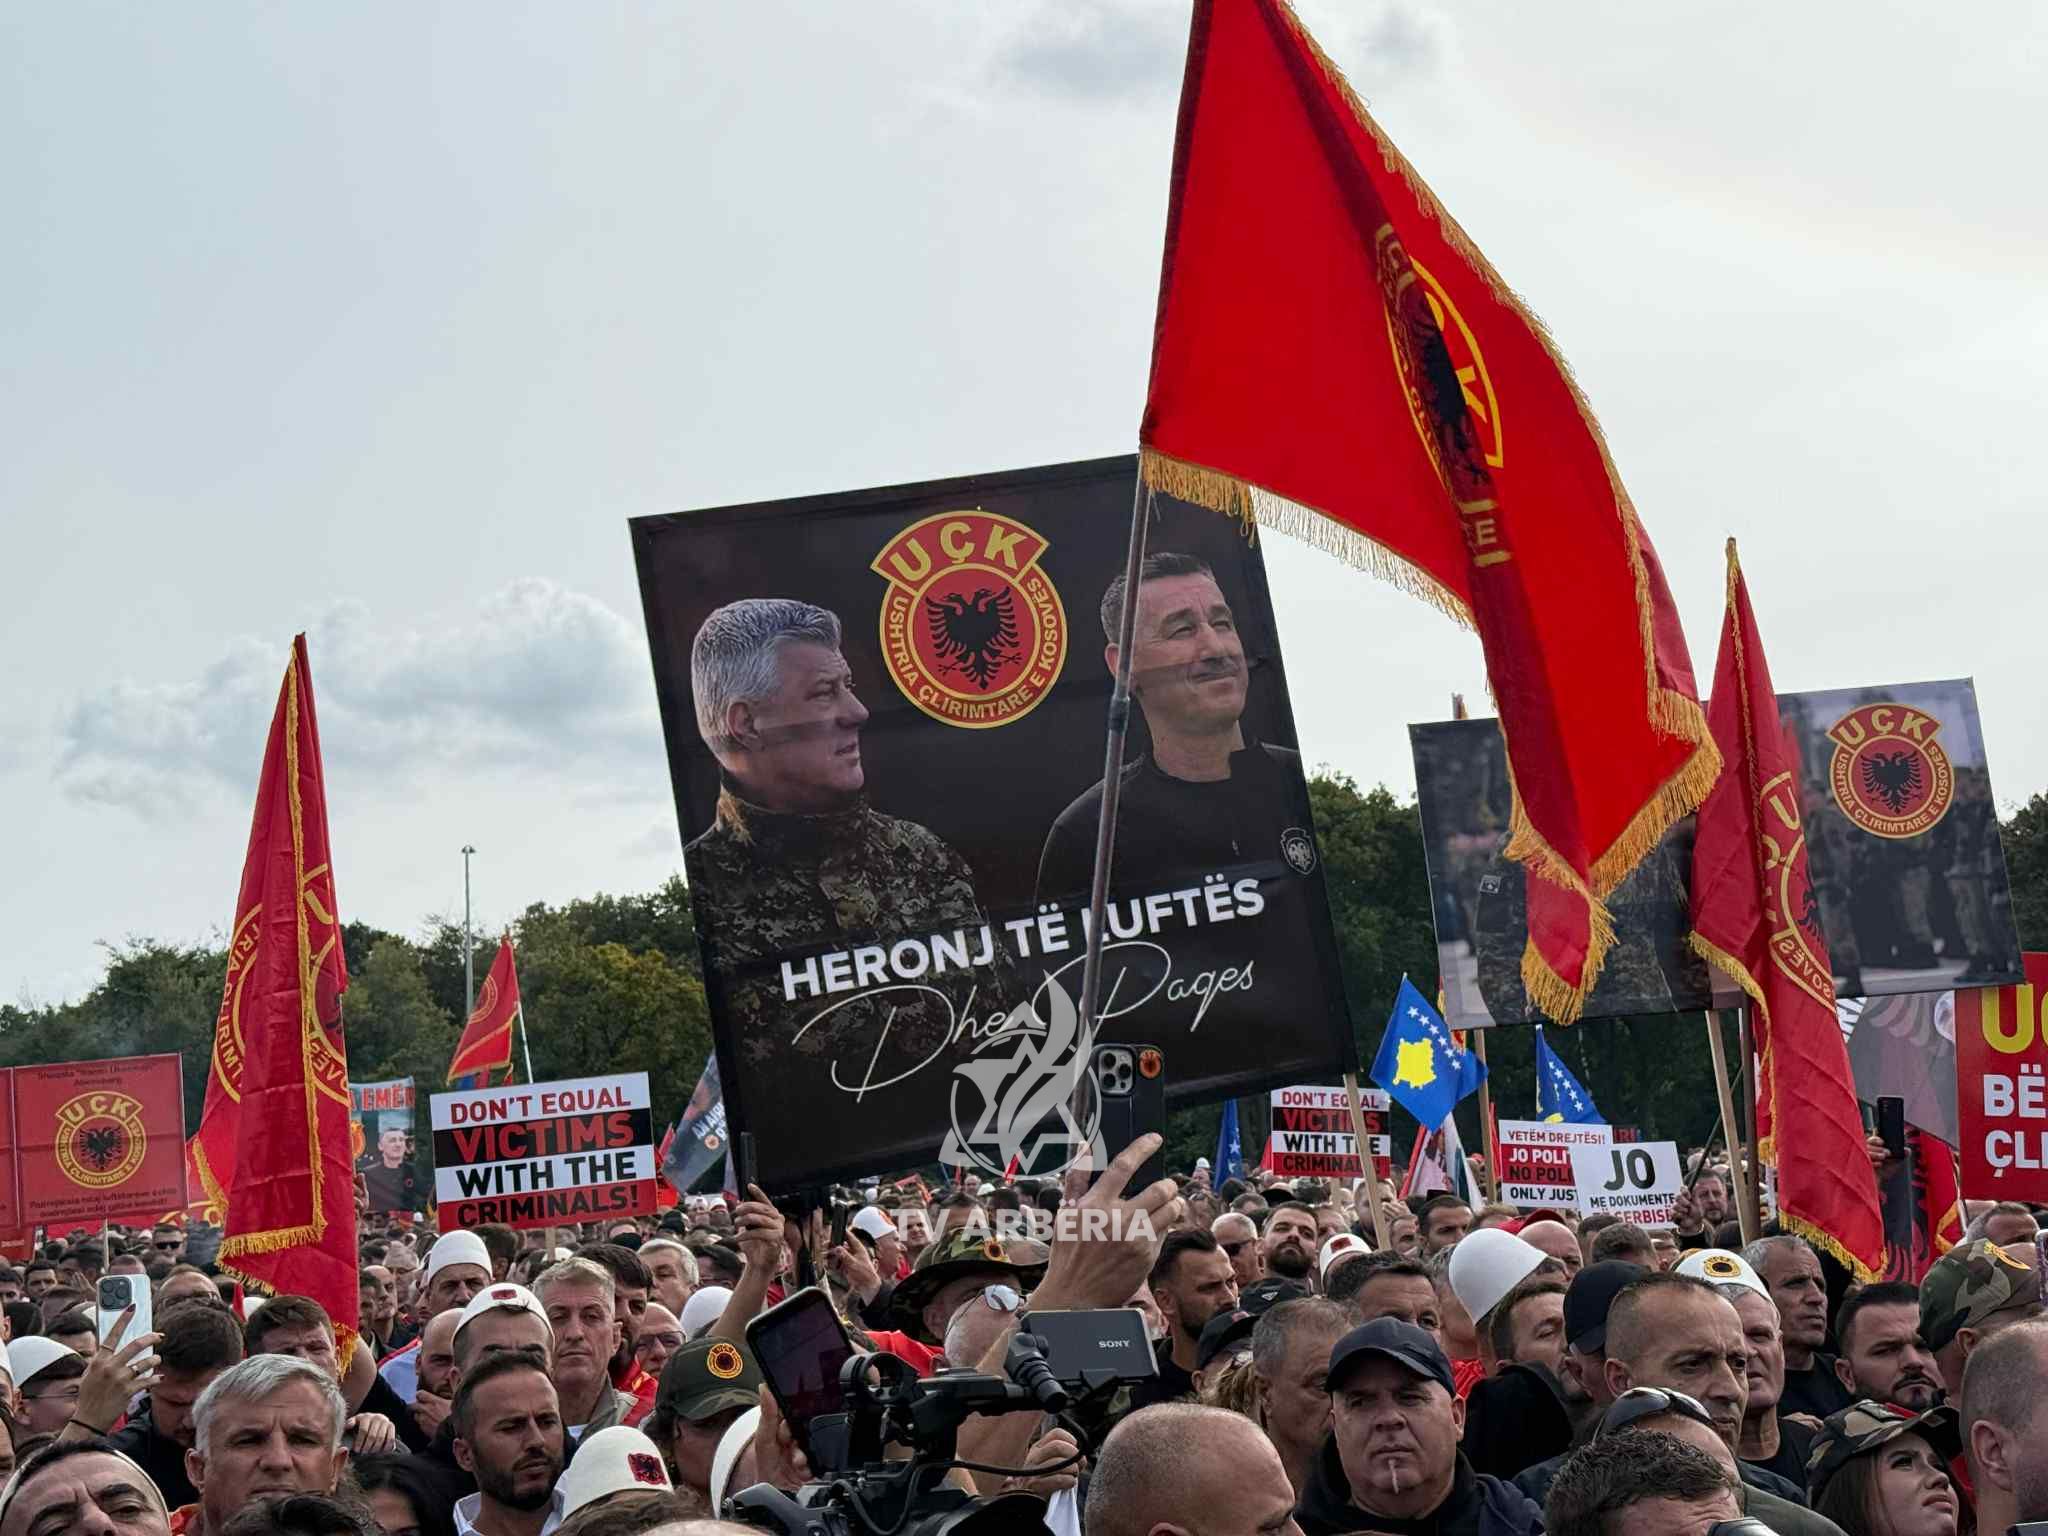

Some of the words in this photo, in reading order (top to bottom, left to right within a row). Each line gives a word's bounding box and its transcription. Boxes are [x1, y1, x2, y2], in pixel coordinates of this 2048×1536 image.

[889, 521, 1027, 582] UÇK
[889, 596, 920, 687] USHTRIA
[1026, 577, 1058, 671] KOSOVËS
[1029, 671, 1046, 688] E
[918, 684, 1033, 720] ÇLIRIMTARE
[1838, 708, 1929, 745] UÇK
[1833, 753, 1854, 810] USHTRIA
[1854, 807, 1931, 833] ÇLIRIMTARE
[1928, 806, 1938, 816] E
[779, 926, 996, 1001] HERONJ
[1004, 903, 1070, 958] TË
[450, 1096, 533, 1124] DON'T
[541, 1086, 631, 1115] EQUAL
[1282, 1091, 1326, 1105] DON'T
[1331, 1093, 1379, 1108] EQAL
[1984, 1064, 2047, 1118] BË
[452, 1112, 634, 1164] VICTIMS
[1283, 1109, 1380, 1133] VICTIS
[1508, 1128, 1545, 1141] VETËM
[1283, 1134, 1336, 1153] WITH
[1342, 1136, 1380, 1155] TE
[1509, 1148, 1528, 1163] JO
[456, 1160, 554, 1197] WITH
[564, 1151, 637, 1185] THE
[1509, 1165, 1531, 1180] NO
[1603, 1148, 1656, 1191] JO
[457, 1184, 638, 1227] CRIMINALS!
[1510, 1186, 1546, 1200] ONLY
[1590, 1196, 1607, 1208] ME
[1098, 1339, 1131, 1349] SONY
